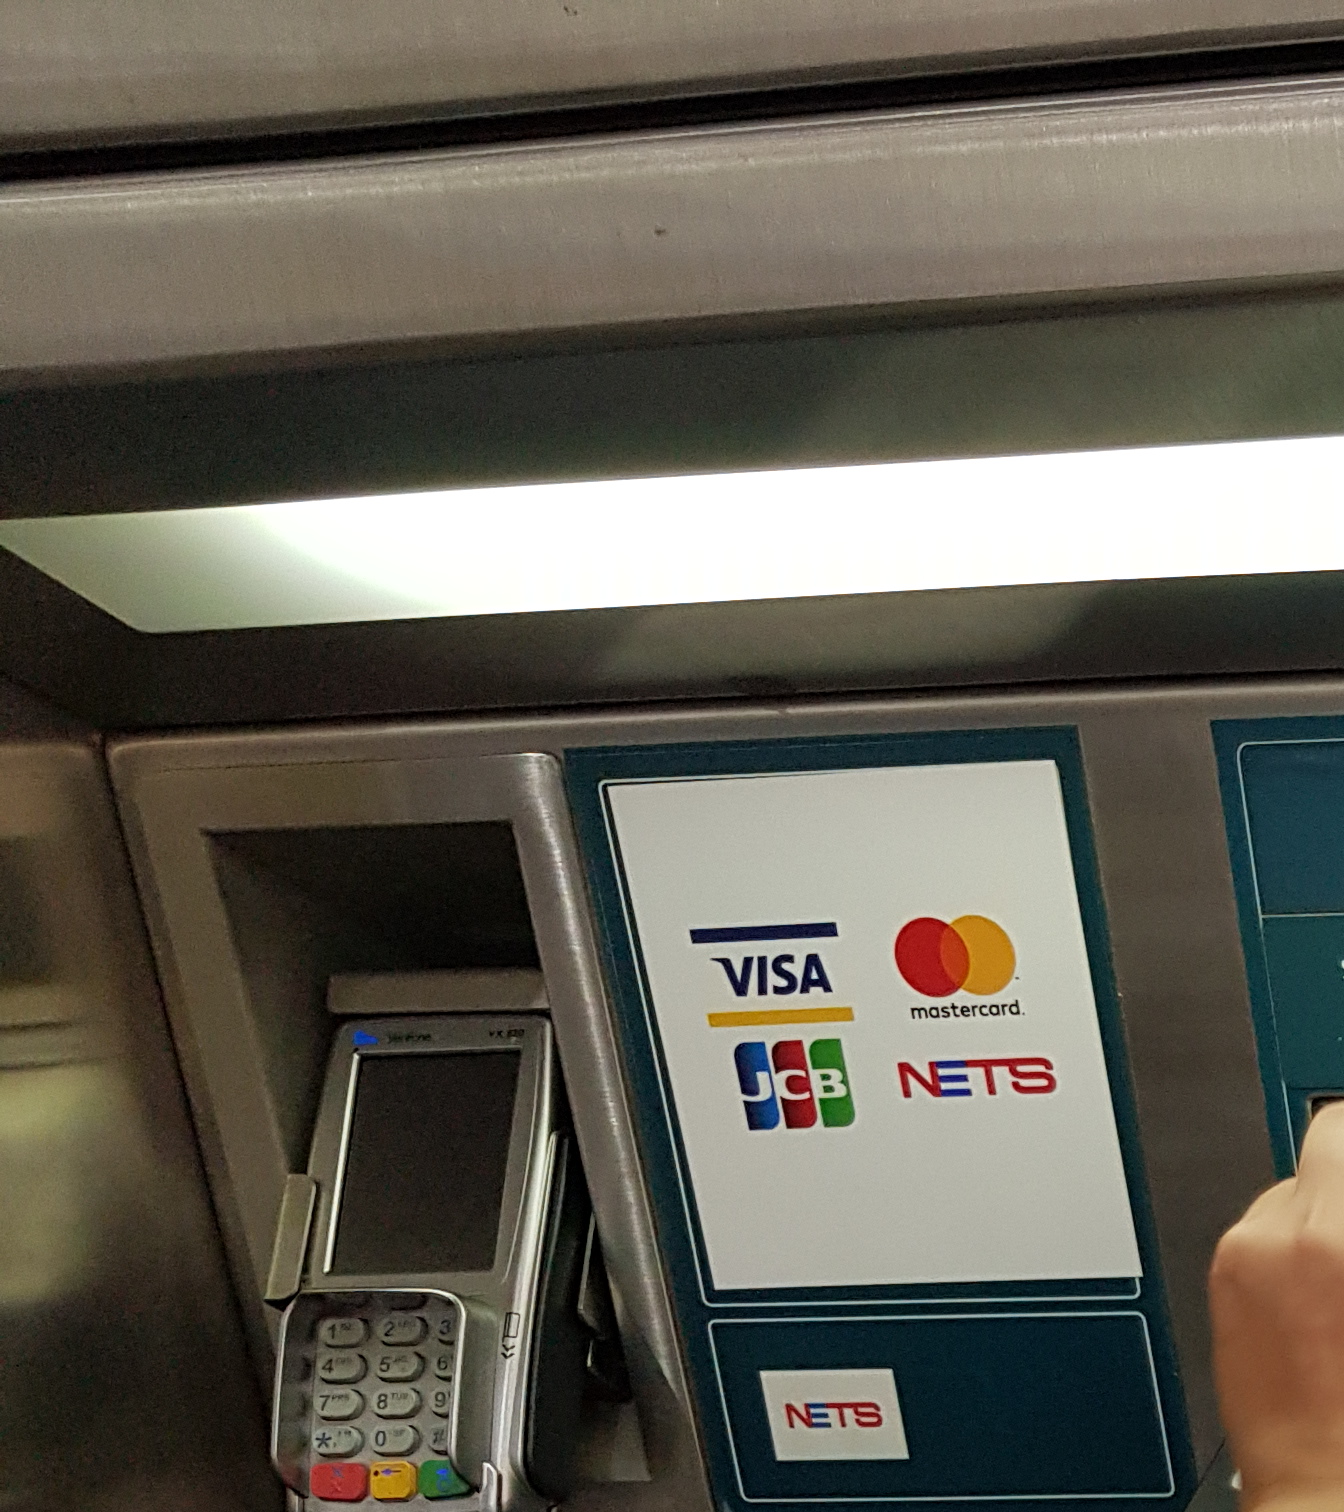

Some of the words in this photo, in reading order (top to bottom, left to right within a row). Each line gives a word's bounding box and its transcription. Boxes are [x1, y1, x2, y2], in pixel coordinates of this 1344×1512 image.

[710, 953, 833, 997] VISA
[897, 1057, 1057, 1099] NETS
[327, 1324, 337, 1340] 1
[383, 1321, 395, 1337] 2
[439, 1320, 451, 1335] 3
[321, 1358, 335, 1374] 4
[379, 1356, 390, 1373] 5
[436, 1355, 448, 1370] 6
[319, 1394, 331, 1412] 7
[376, 1394, 388, 1410] 8
[434, 1391, 446, 1407] 9
[784, 1402, 883, 1429] NETS
[375, 1430, 386, 1447] 0
